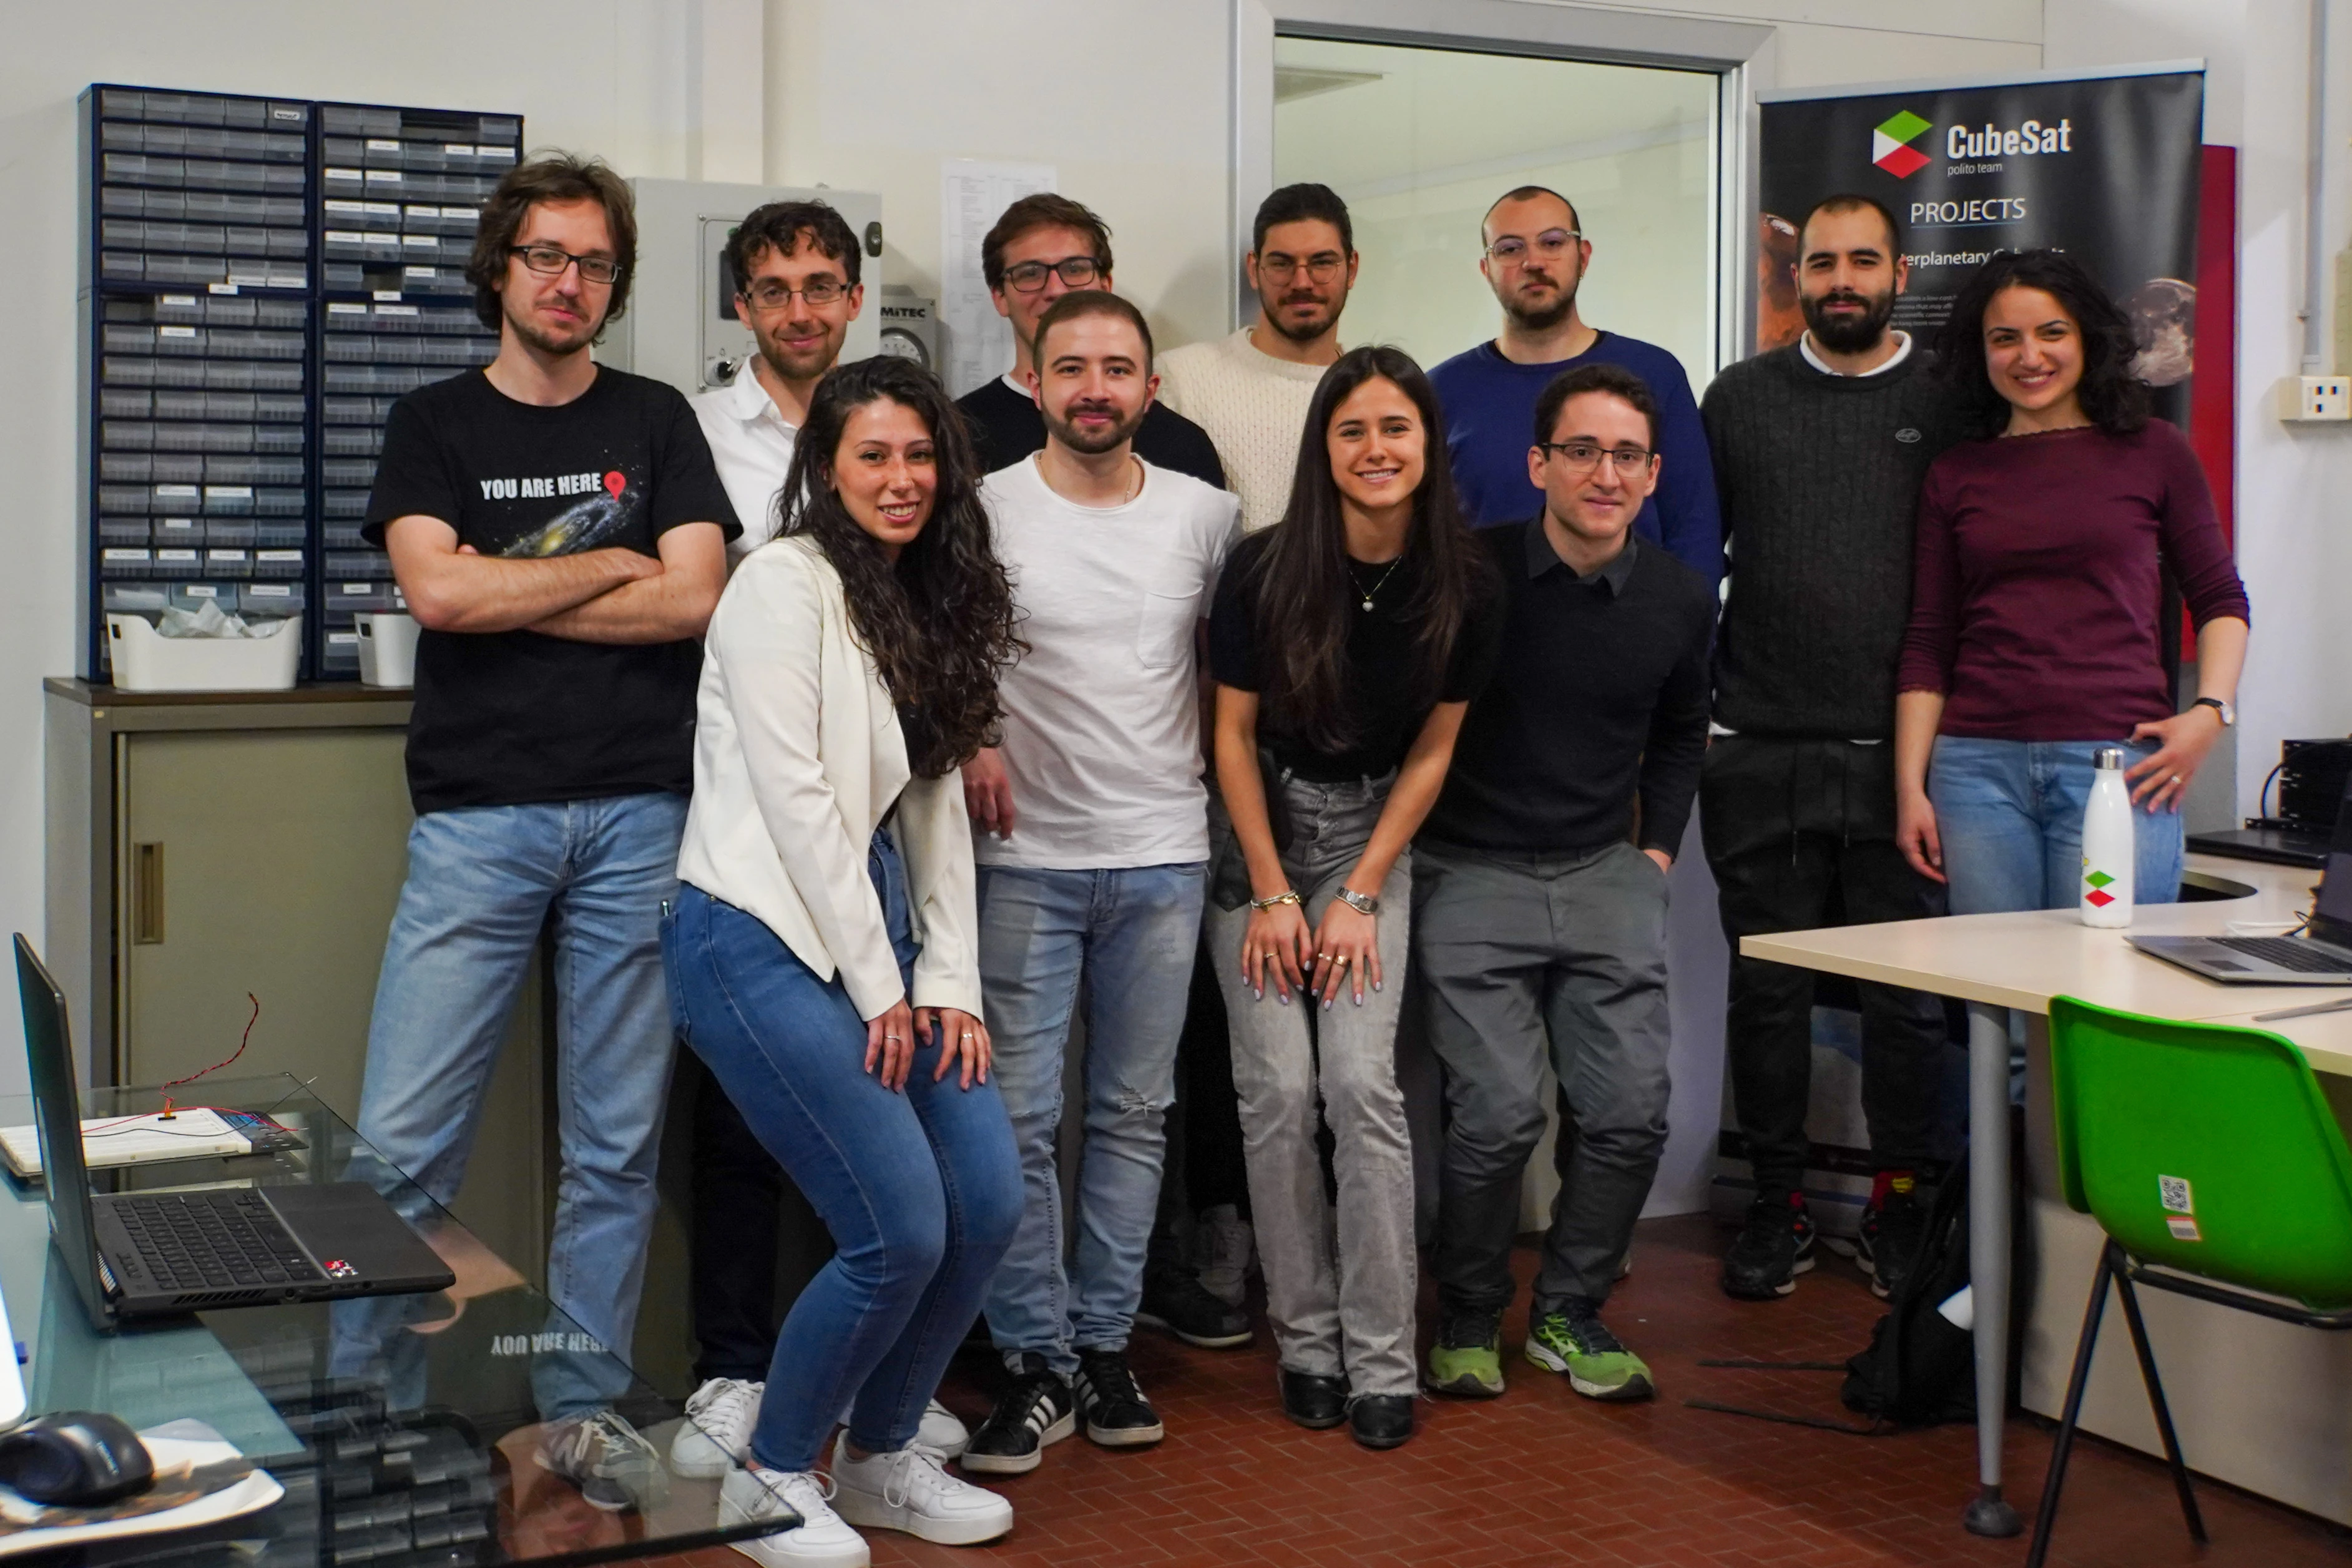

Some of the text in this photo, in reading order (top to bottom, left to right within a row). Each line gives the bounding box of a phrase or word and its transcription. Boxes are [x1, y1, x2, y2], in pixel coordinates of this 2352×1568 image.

[1947, 119, 2072, 159] CubeSat
[1948, 162, 2002, 177] polito team
[1911, 198, 2026, 223] PROJECTS
[1901, 249, 1989, 268] erplanetary
[480, 472, 602, 500] YOU ARE HERE
